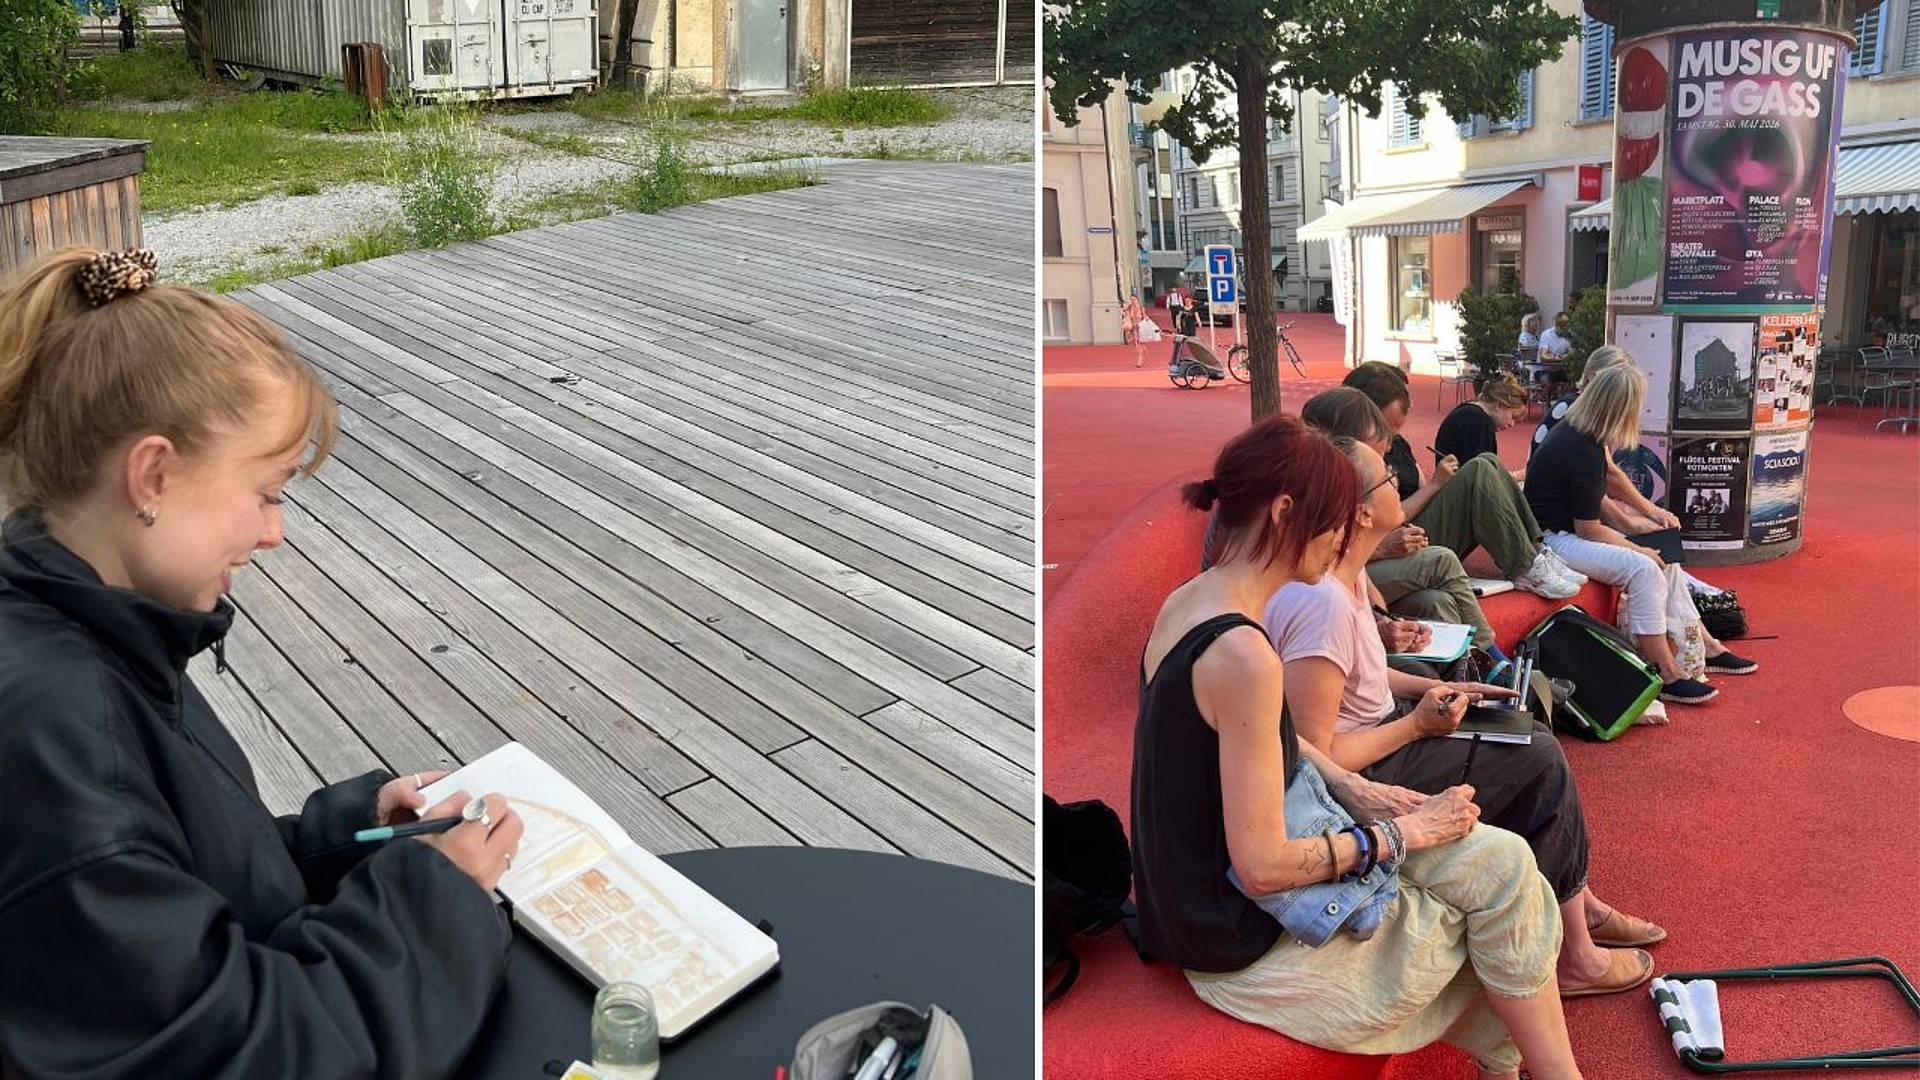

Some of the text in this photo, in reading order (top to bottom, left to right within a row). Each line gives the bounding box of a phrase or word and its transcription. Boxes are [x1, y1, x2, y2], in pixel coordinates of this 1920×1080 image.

[1678, 38, 1835, 80] MUSIG UF
[1678, 78, 1821, 118] DE GASS
[1672, 195, 1724, 205] MARKTPLATZ
[1749, 195, 1780, 205] PALACE
[1670, 242, 1703, 250] THEATER
[1670, 249, 1717, 258] TROUVAILLE
[1217, 280, 1229, 299] P
[1679, 455, 1741, 464] FLÜGEL FESTIVAL
[1687, 464, 1733, 472] ROTMONTEN
